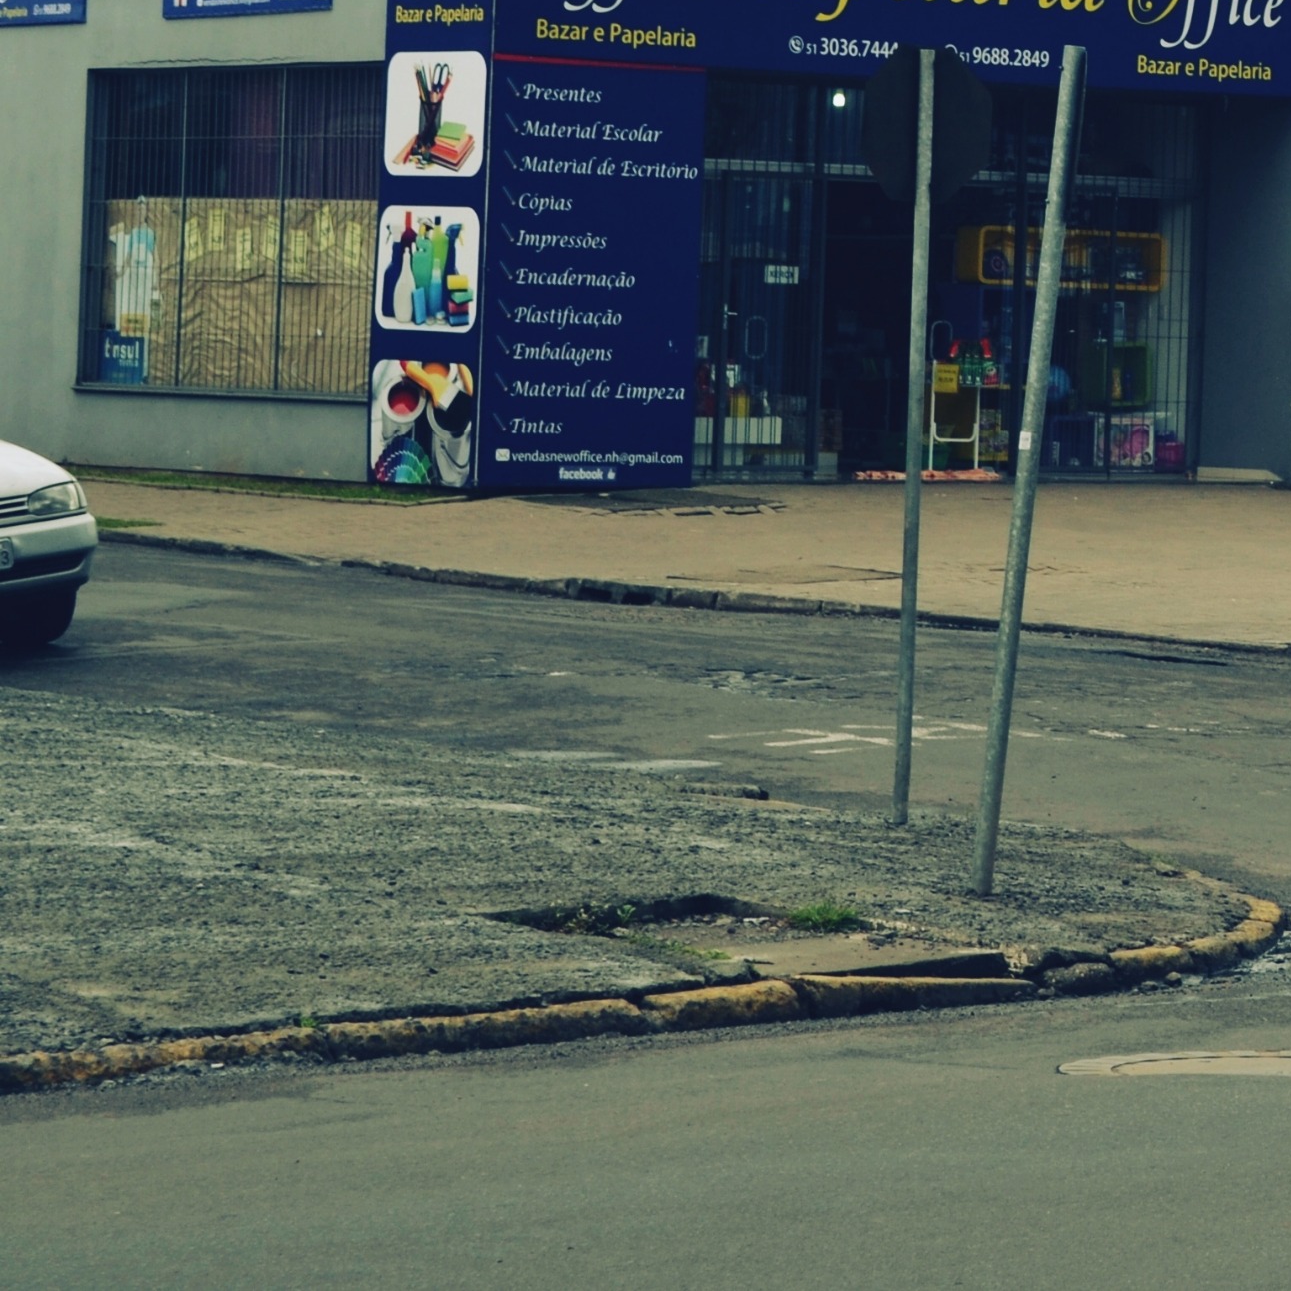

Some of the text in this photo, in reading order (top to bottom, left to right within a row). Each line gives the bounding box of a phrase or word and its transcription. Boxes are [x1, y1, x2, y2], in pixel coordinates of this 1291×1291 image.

[395, 4, 484, 27] Bazar e Papelaria
[536, 19, 697, 50] Bazar e Papelaria
[806, 44, 817, 55] 51
[959, 47, 1049, 67] 51 9688.2849
[1137, 54, 1271, 83] Bazar e Papelaria
[522, 82, 602, 105] Presentes
[520, 119, 663, 144] Material Escolar
[518, 154, 699, 181] Material de Escritório
[518, 191, 573, 217] Cópias
[516, 228, 607, 253] Impressões
[515, 266, 636, 290] Encadernação
[513, 305, 622, 330] Plastificação
[105, 337, 139, 359] tnsul
[512, 343, 613, 366] Embalagens
[510, 378, 686, 405] Material de Limpeza
[509, 417, 563, 435] Tintas
[511, 449, 683, 469] vendasnewoffice.nh@gmail.com
[558, 467, 604, 481] facebook
